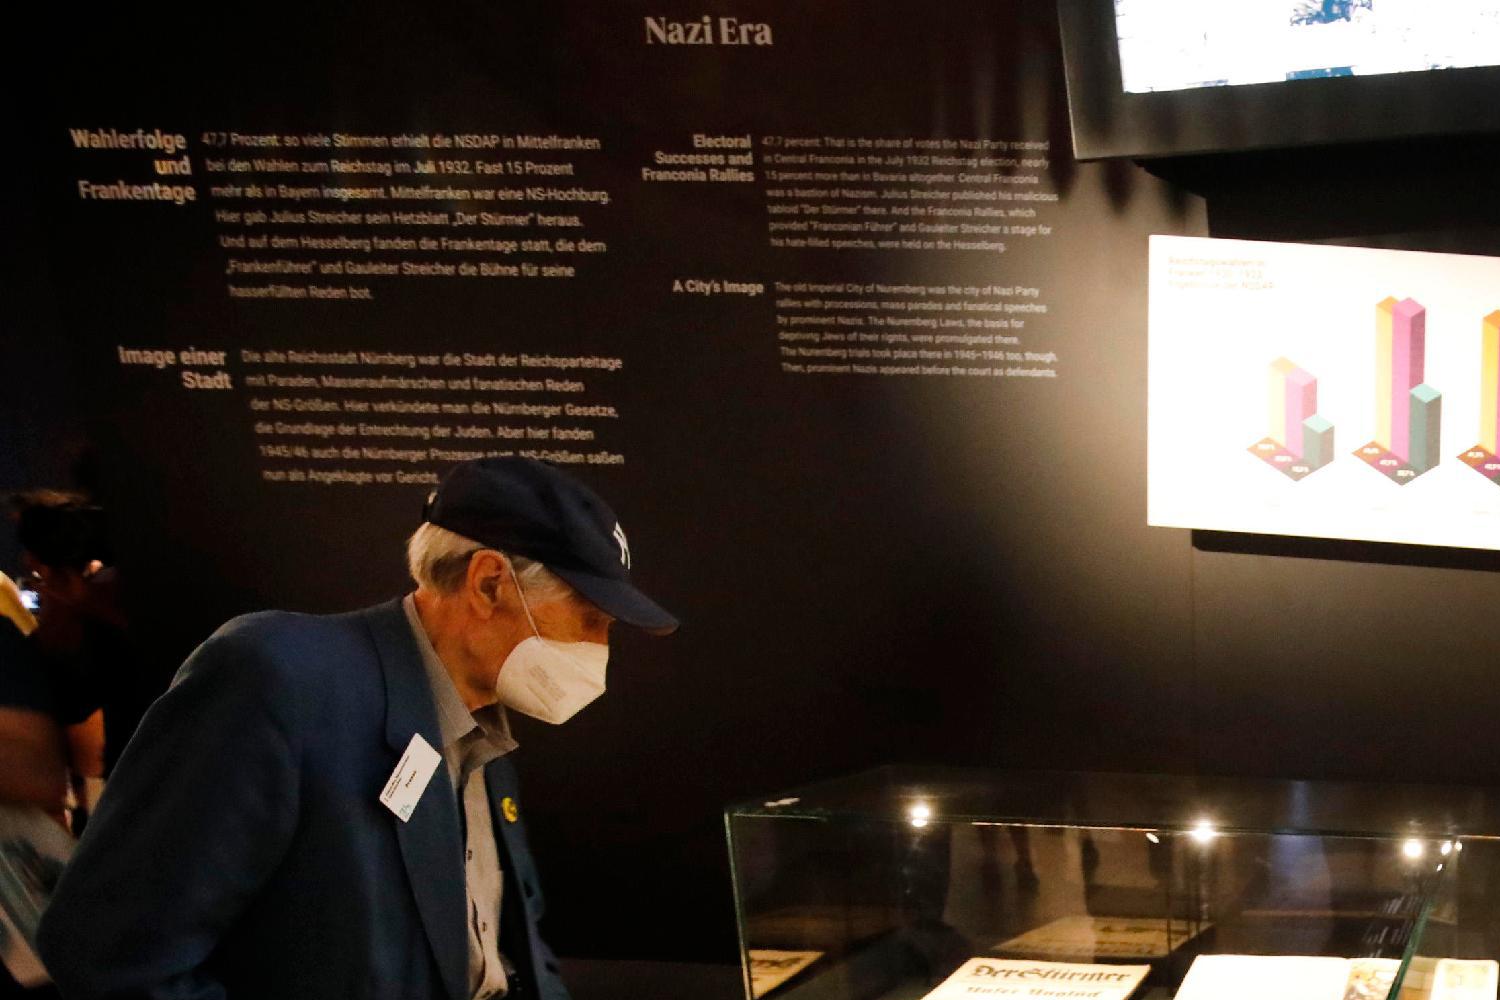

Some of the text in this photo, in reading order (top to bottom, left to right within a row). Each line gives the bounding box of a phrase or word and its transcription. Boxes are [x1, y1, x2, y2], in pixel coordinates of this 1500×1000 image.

[644, 15, 773, 45] Nazi Era
[70, 127, 188, 155] Wahlerfolge
[454, 134, 500, 148] NSDAP
[502, 134, 514, 148] in
[516, 135, 600, 149] Mittelfranken
[693, 133, 751, 149] Electoral
[155, 155, 192, 176] und
[655, 150, 753, 167] Successes and
[475, 161, 503, 174] Fast
[507, 162, 522, 175] 15
[525, 162, 574, 175] Prozent
[642, 167, 755, 183] Franconia Rallies
[78, 180, 197, 205] Frankentage
[497, 186, 523, 200] eine
[526, 187, 612, 203] NS-Hochburg.
[672, 280, 683, 294] A
[723, 280, 764, 296] Image
[118, 345, 227, 369] Image einer
[181, 371, 233, 391] Stadt
